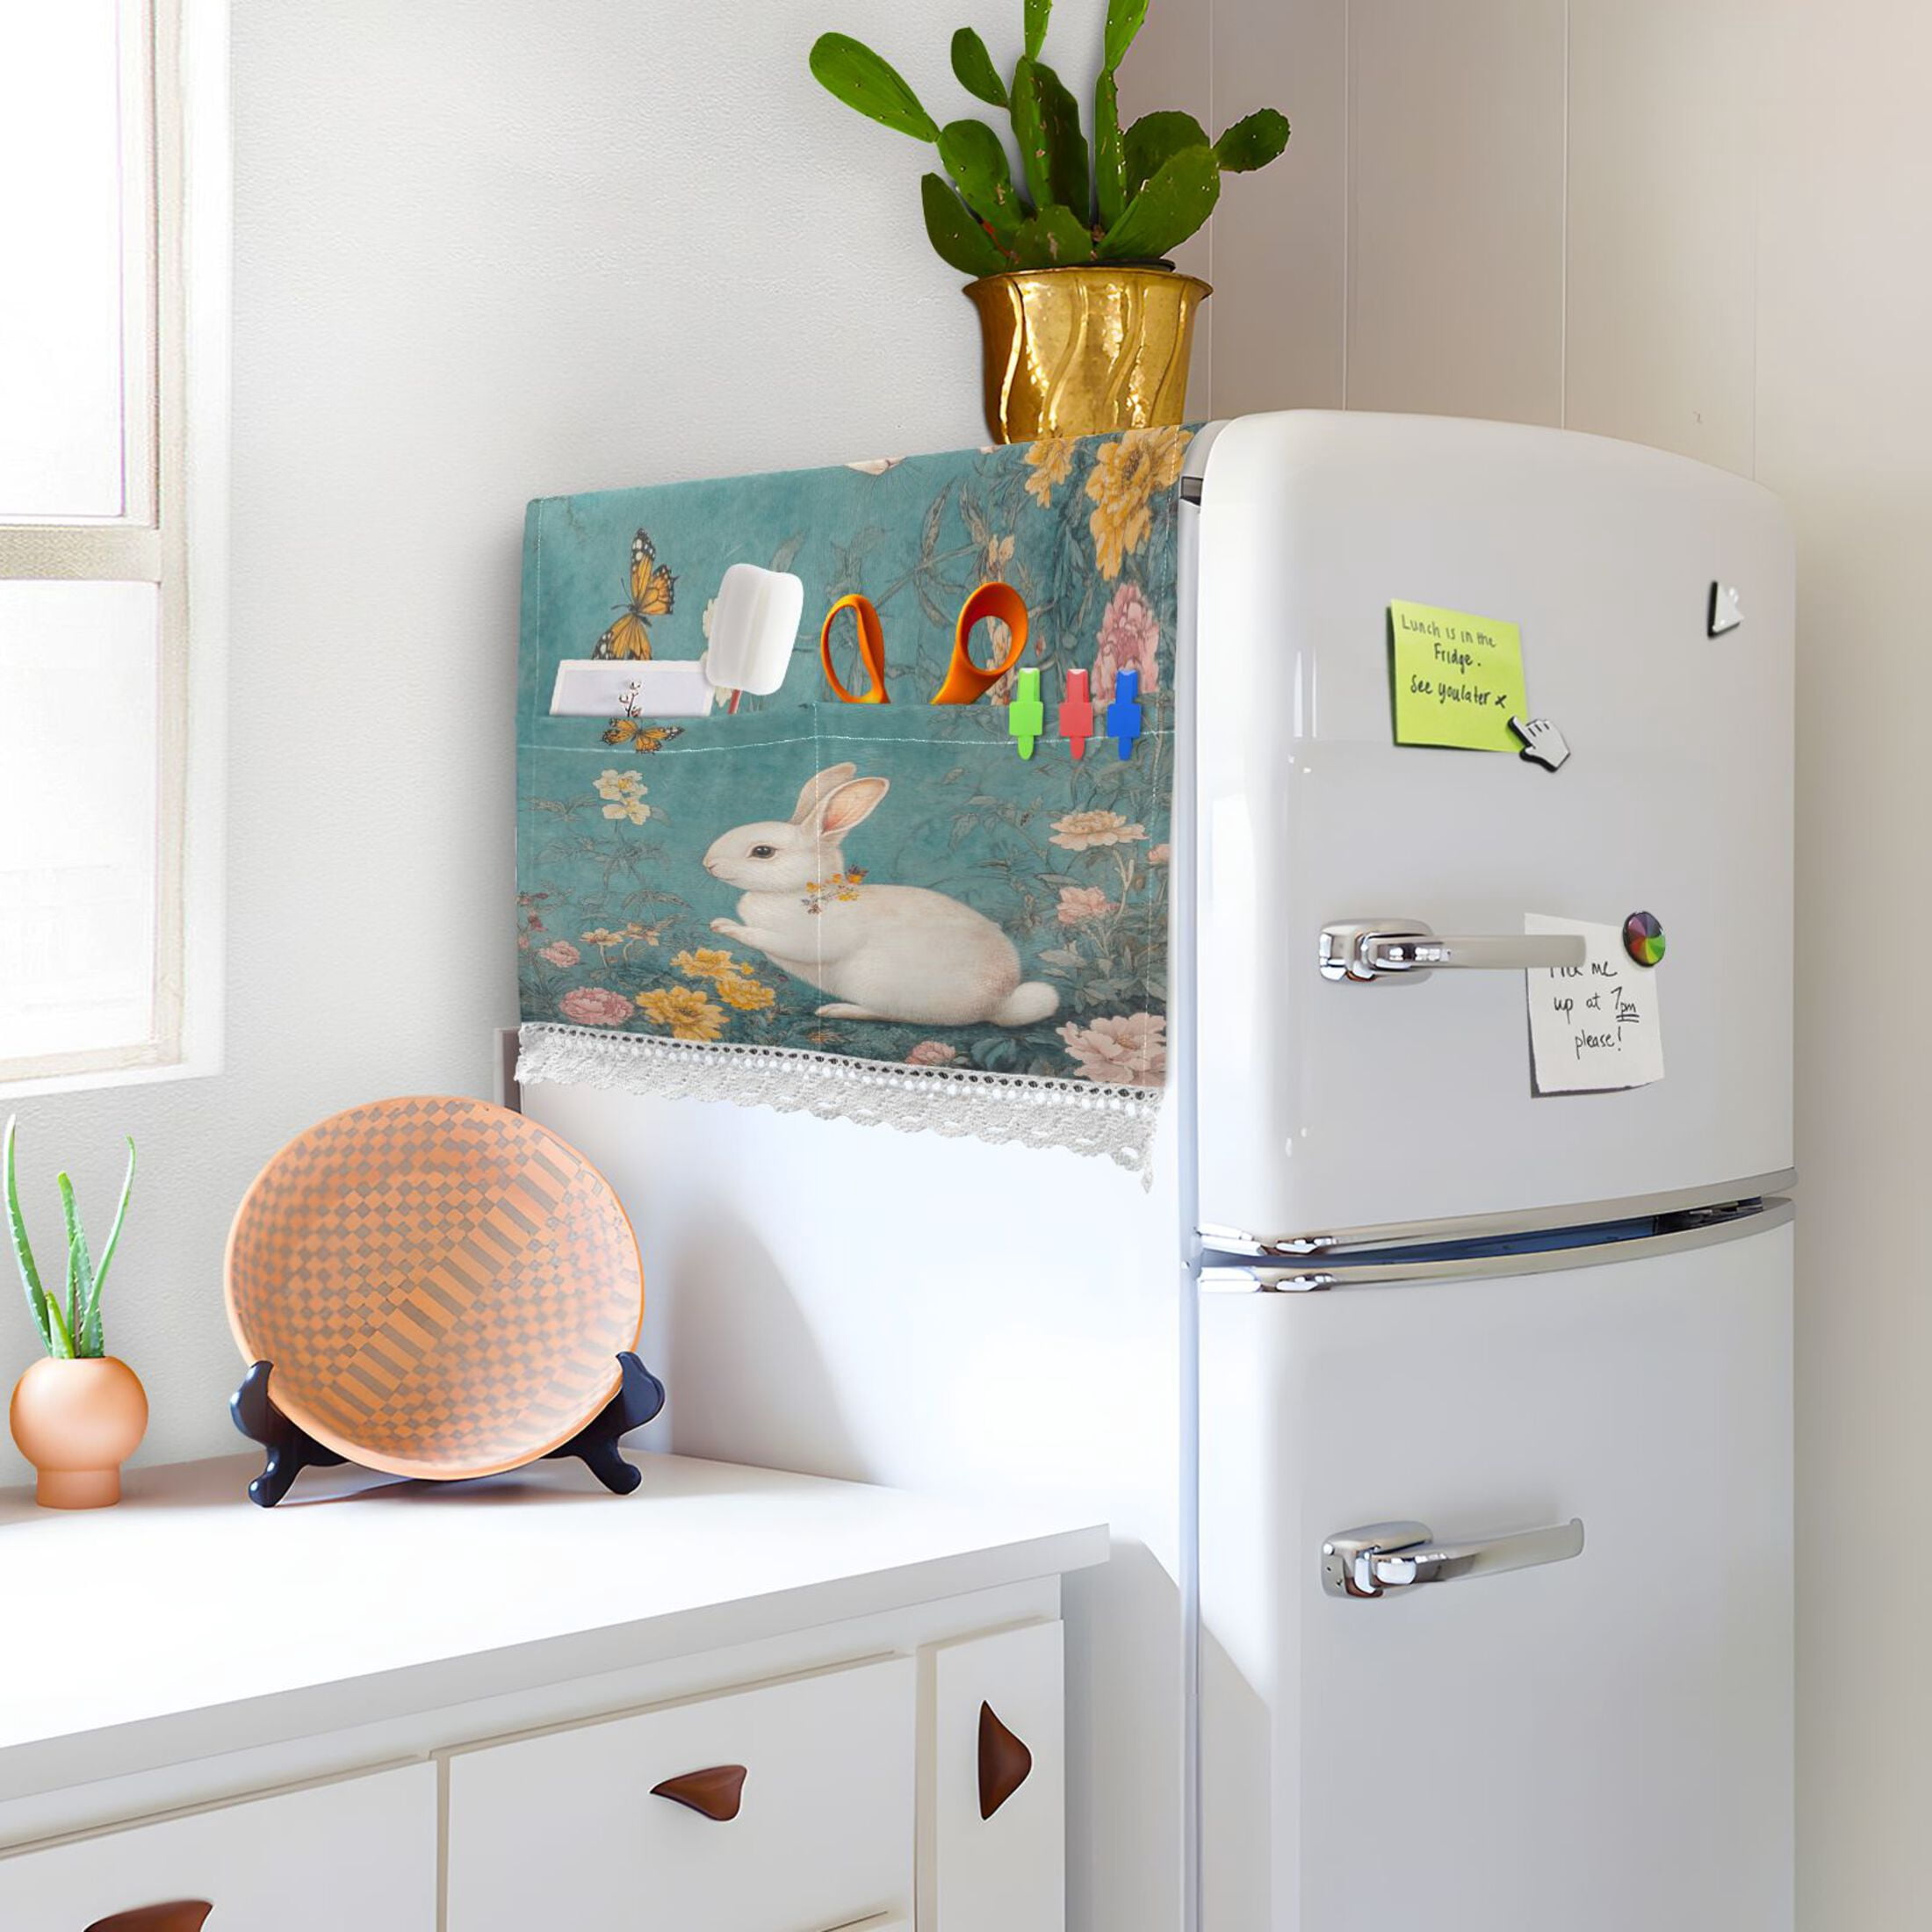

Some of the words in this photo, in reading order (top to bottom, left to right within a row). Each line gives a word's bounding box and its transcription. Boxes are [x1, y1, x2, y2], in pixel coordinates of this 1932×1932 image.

[1401, 614, 1441, 638] Lunch
[1445, 627, 1457, 641] is
[1460, 631, 1474, 644] in
[1476, 632, 1497, 648] the
[1410, 674, 1433, 694] See
[1592, 961, 1618, 977] me
[1554, 996, 1574, 1025] up
[1586, 991, 1601, 1011] at
[1575, 1025, 1622, 1060] please!
